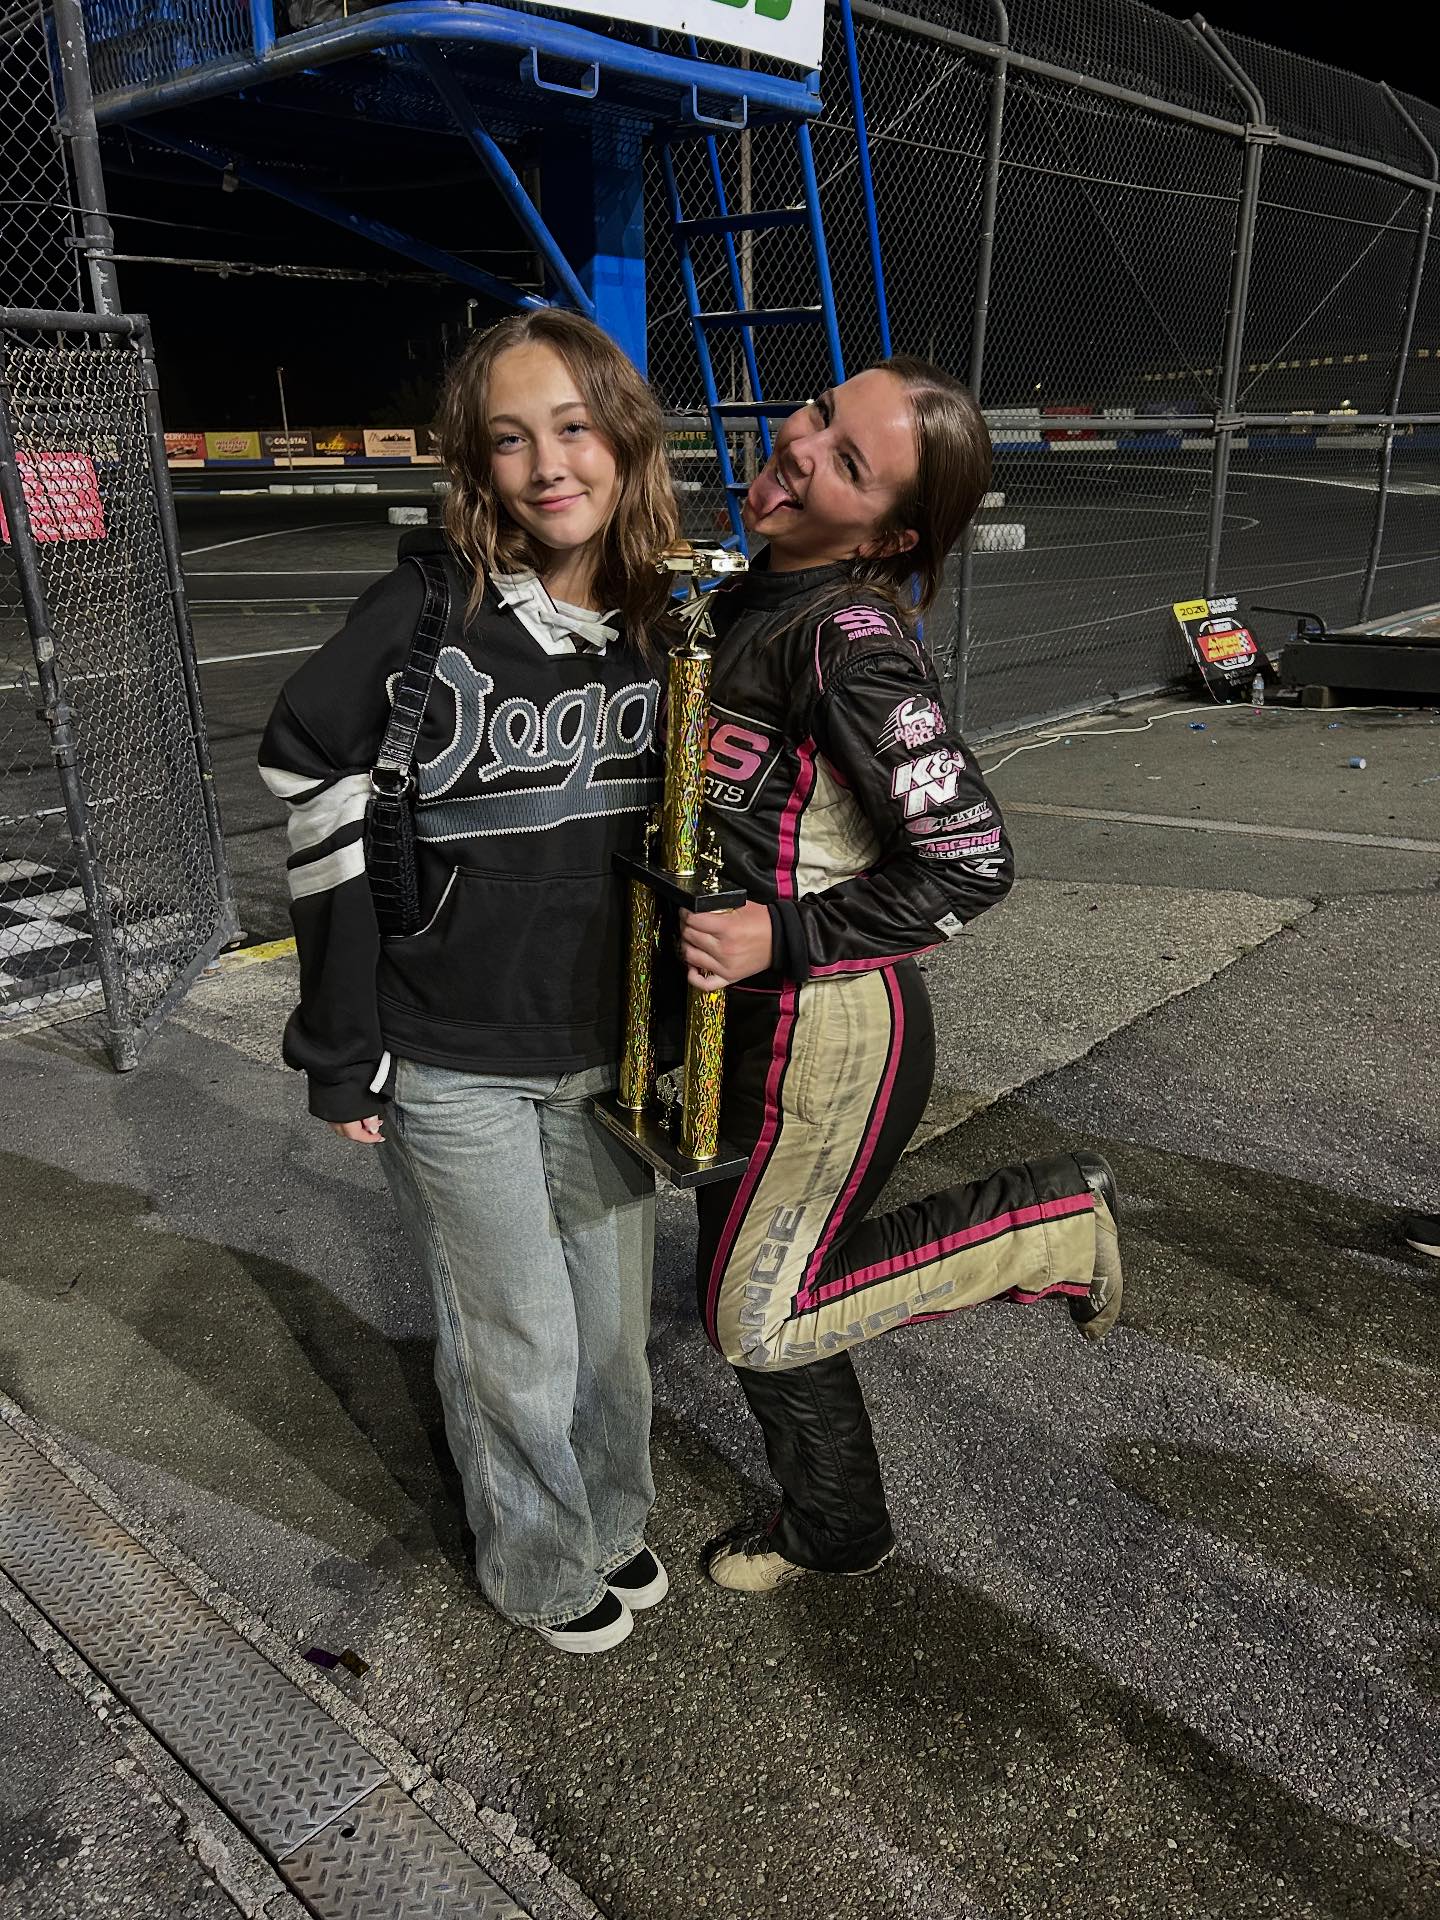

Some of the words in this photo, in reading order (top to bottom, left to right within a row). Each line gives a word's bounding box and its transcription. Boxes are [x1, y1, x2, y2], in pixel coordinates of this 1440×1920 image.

[847, 626, 892, 641] SIMPSON
[893, 719, 926, 742] RACE
[905, 727, 936, 750] FACE
[920, 827, 1001, 854] Marshall
